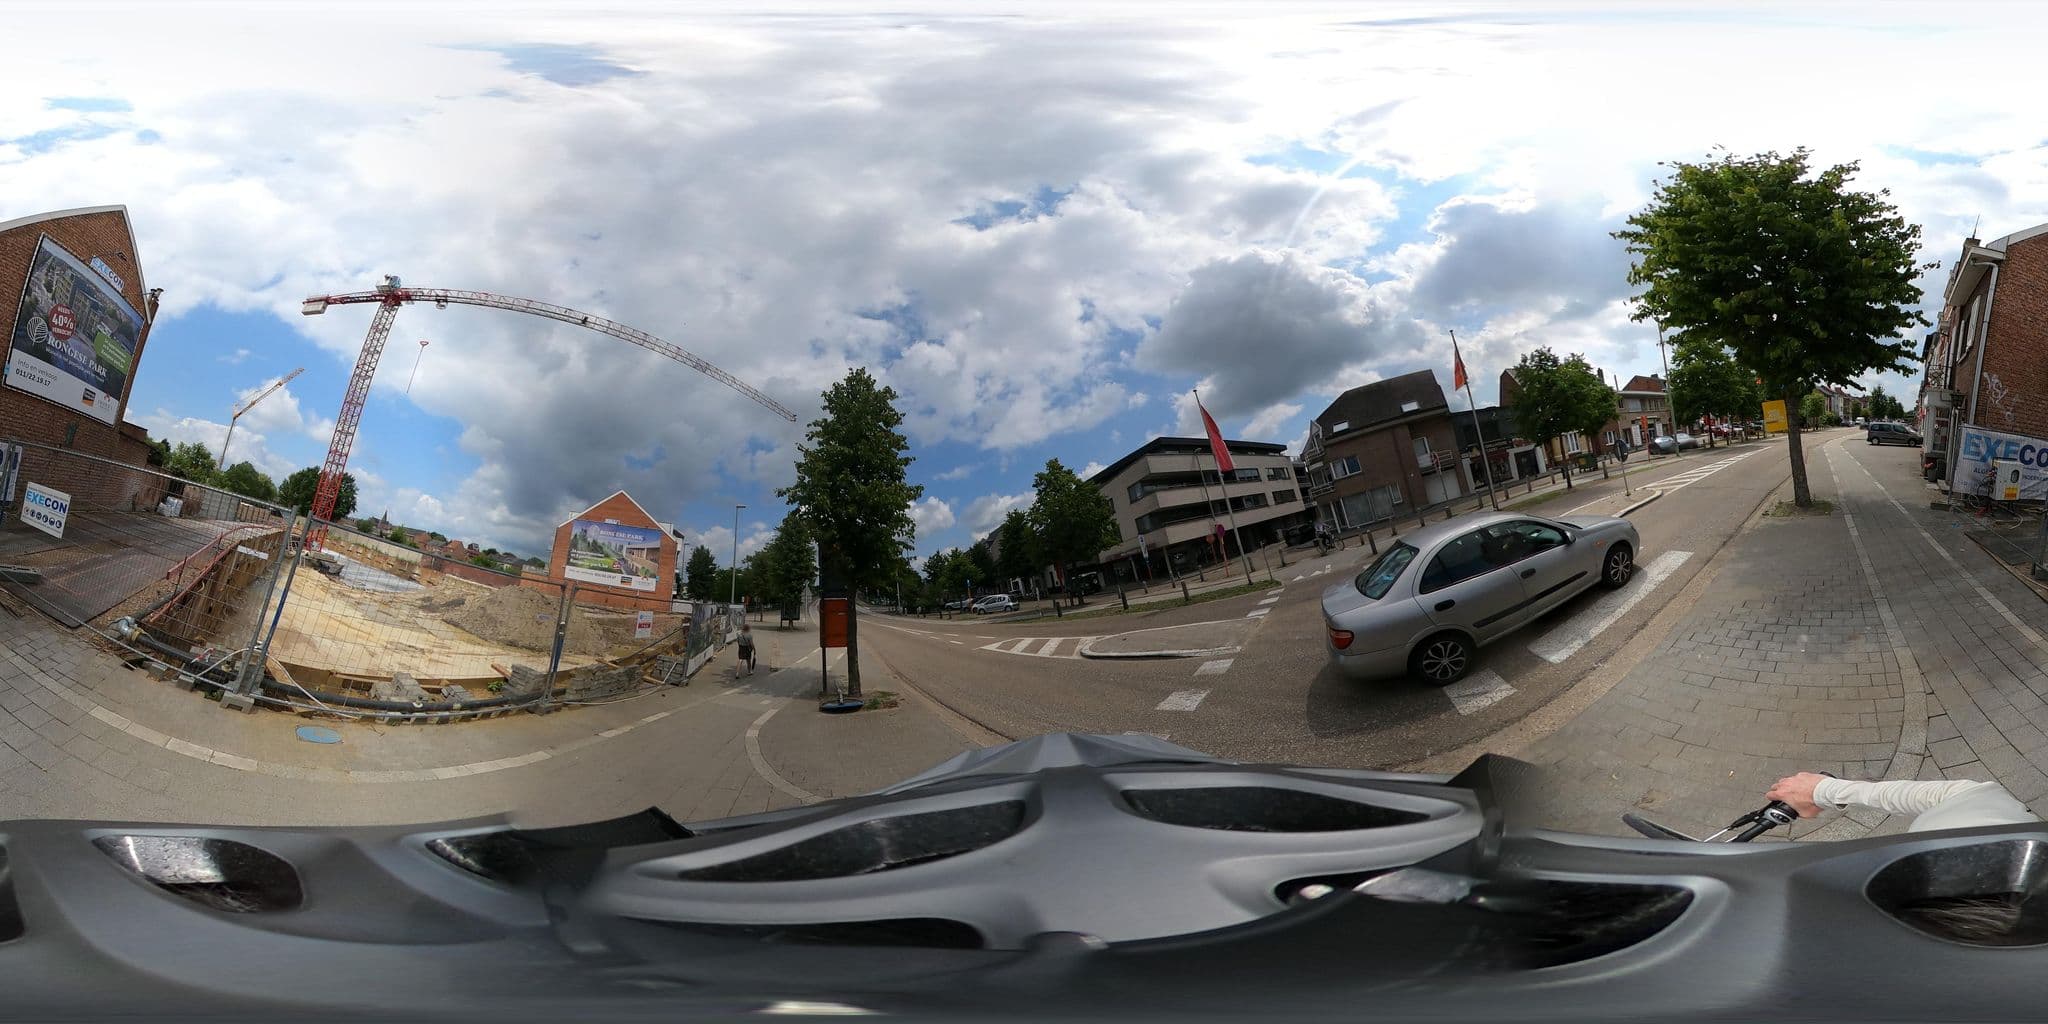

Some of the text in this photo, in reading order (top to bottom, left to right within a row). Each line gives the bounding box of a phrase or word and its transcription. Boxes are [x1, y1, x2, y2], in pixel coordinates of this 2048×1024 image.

[92, 257, 124, 289] EXECON
[52, 313, 74, 330] 40%
[47, 335, 87, 365] RONGESE
[88, 361, 108, 377] PARK
[26, 491, 68, 514] EXECON
